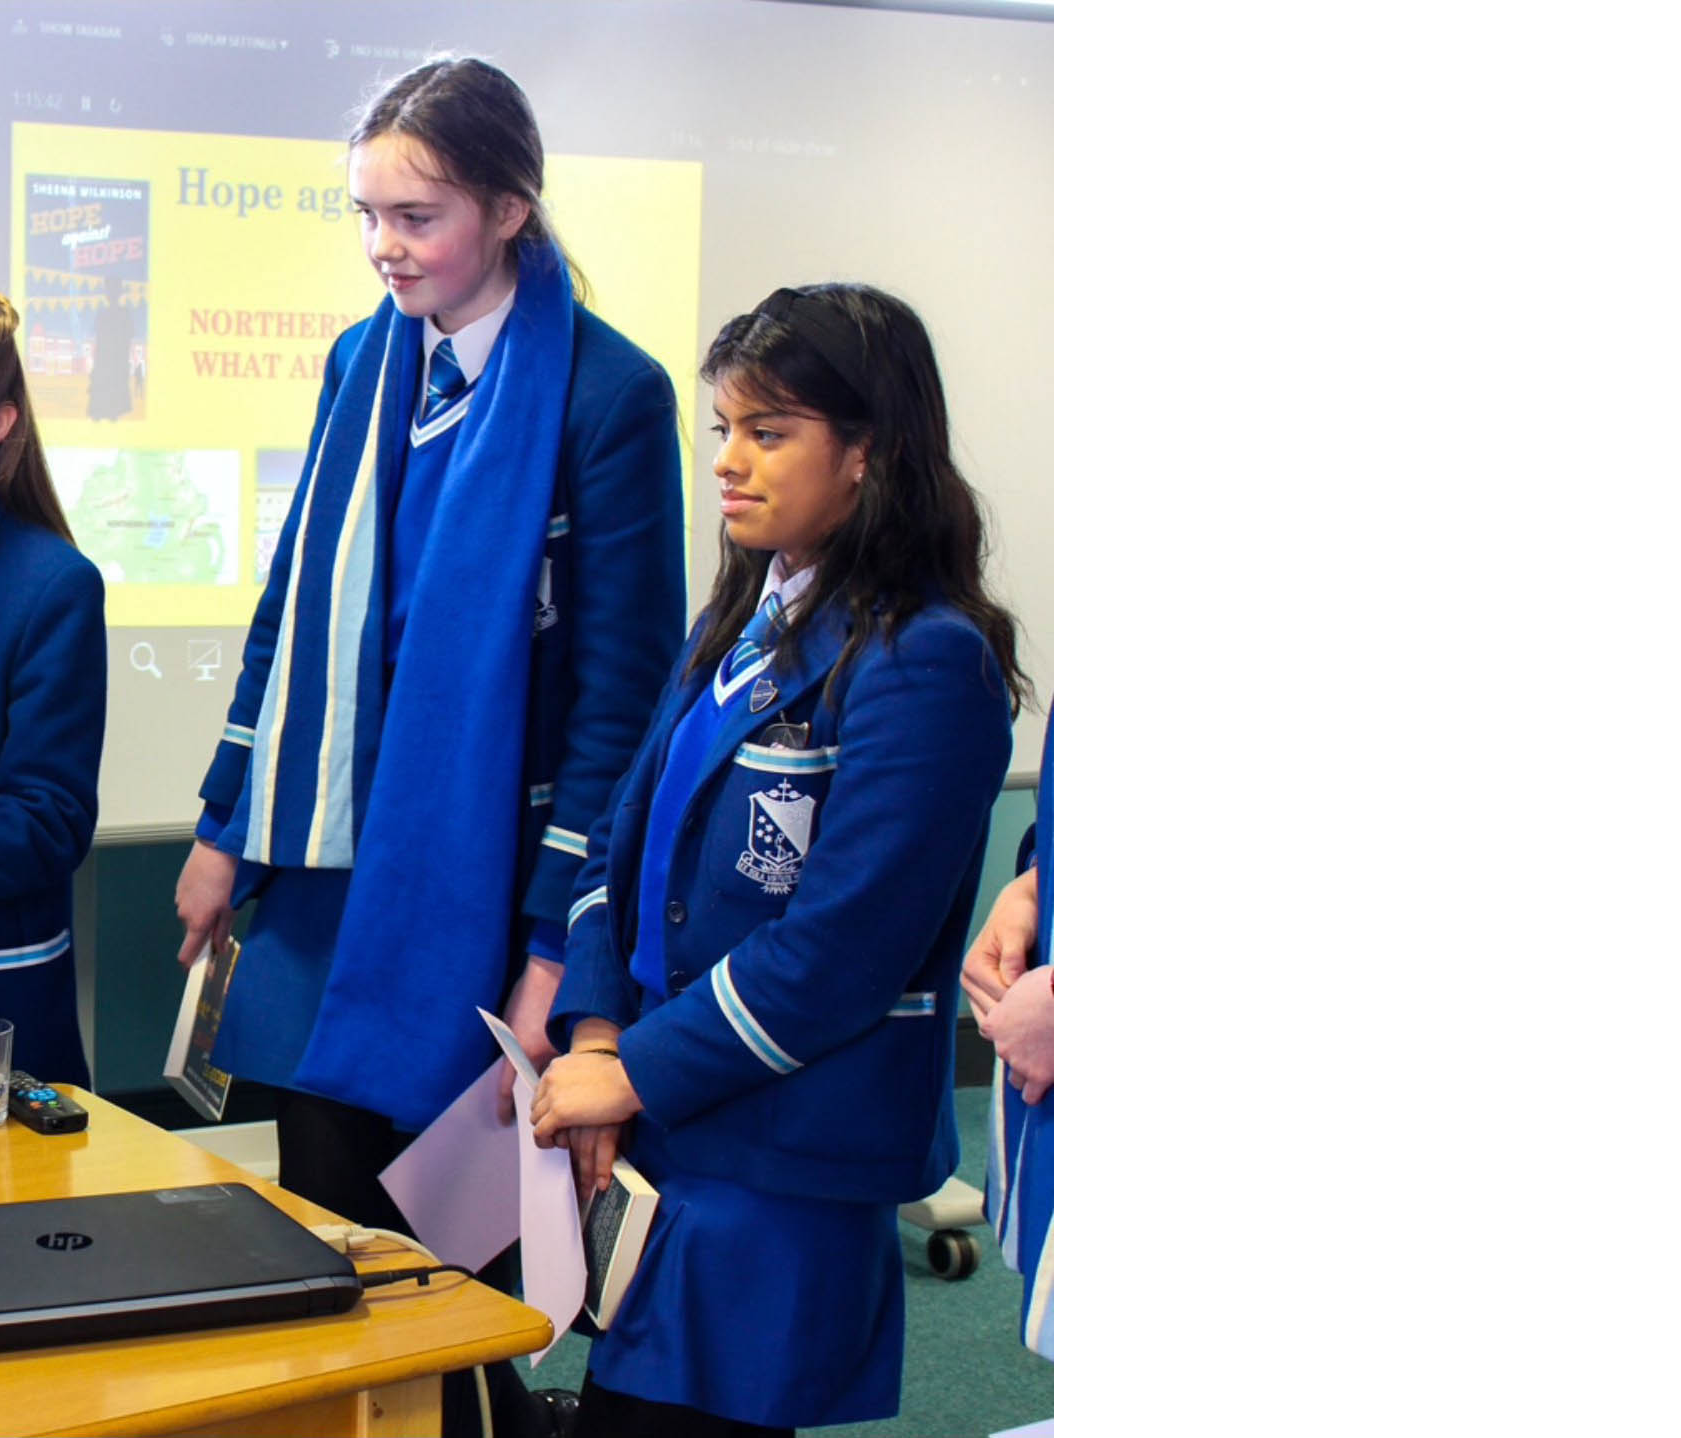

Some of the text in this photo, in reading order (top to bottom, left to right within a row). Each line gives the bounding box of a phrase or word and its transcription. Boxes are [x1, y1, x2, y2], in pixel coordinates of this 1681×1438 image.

[177, 167, 283, 218] Hope
[30, 203, 102, 236] HOPE
[73, 236, 143, 269] HOPE
[192, 351, 281, 380] WHAT
